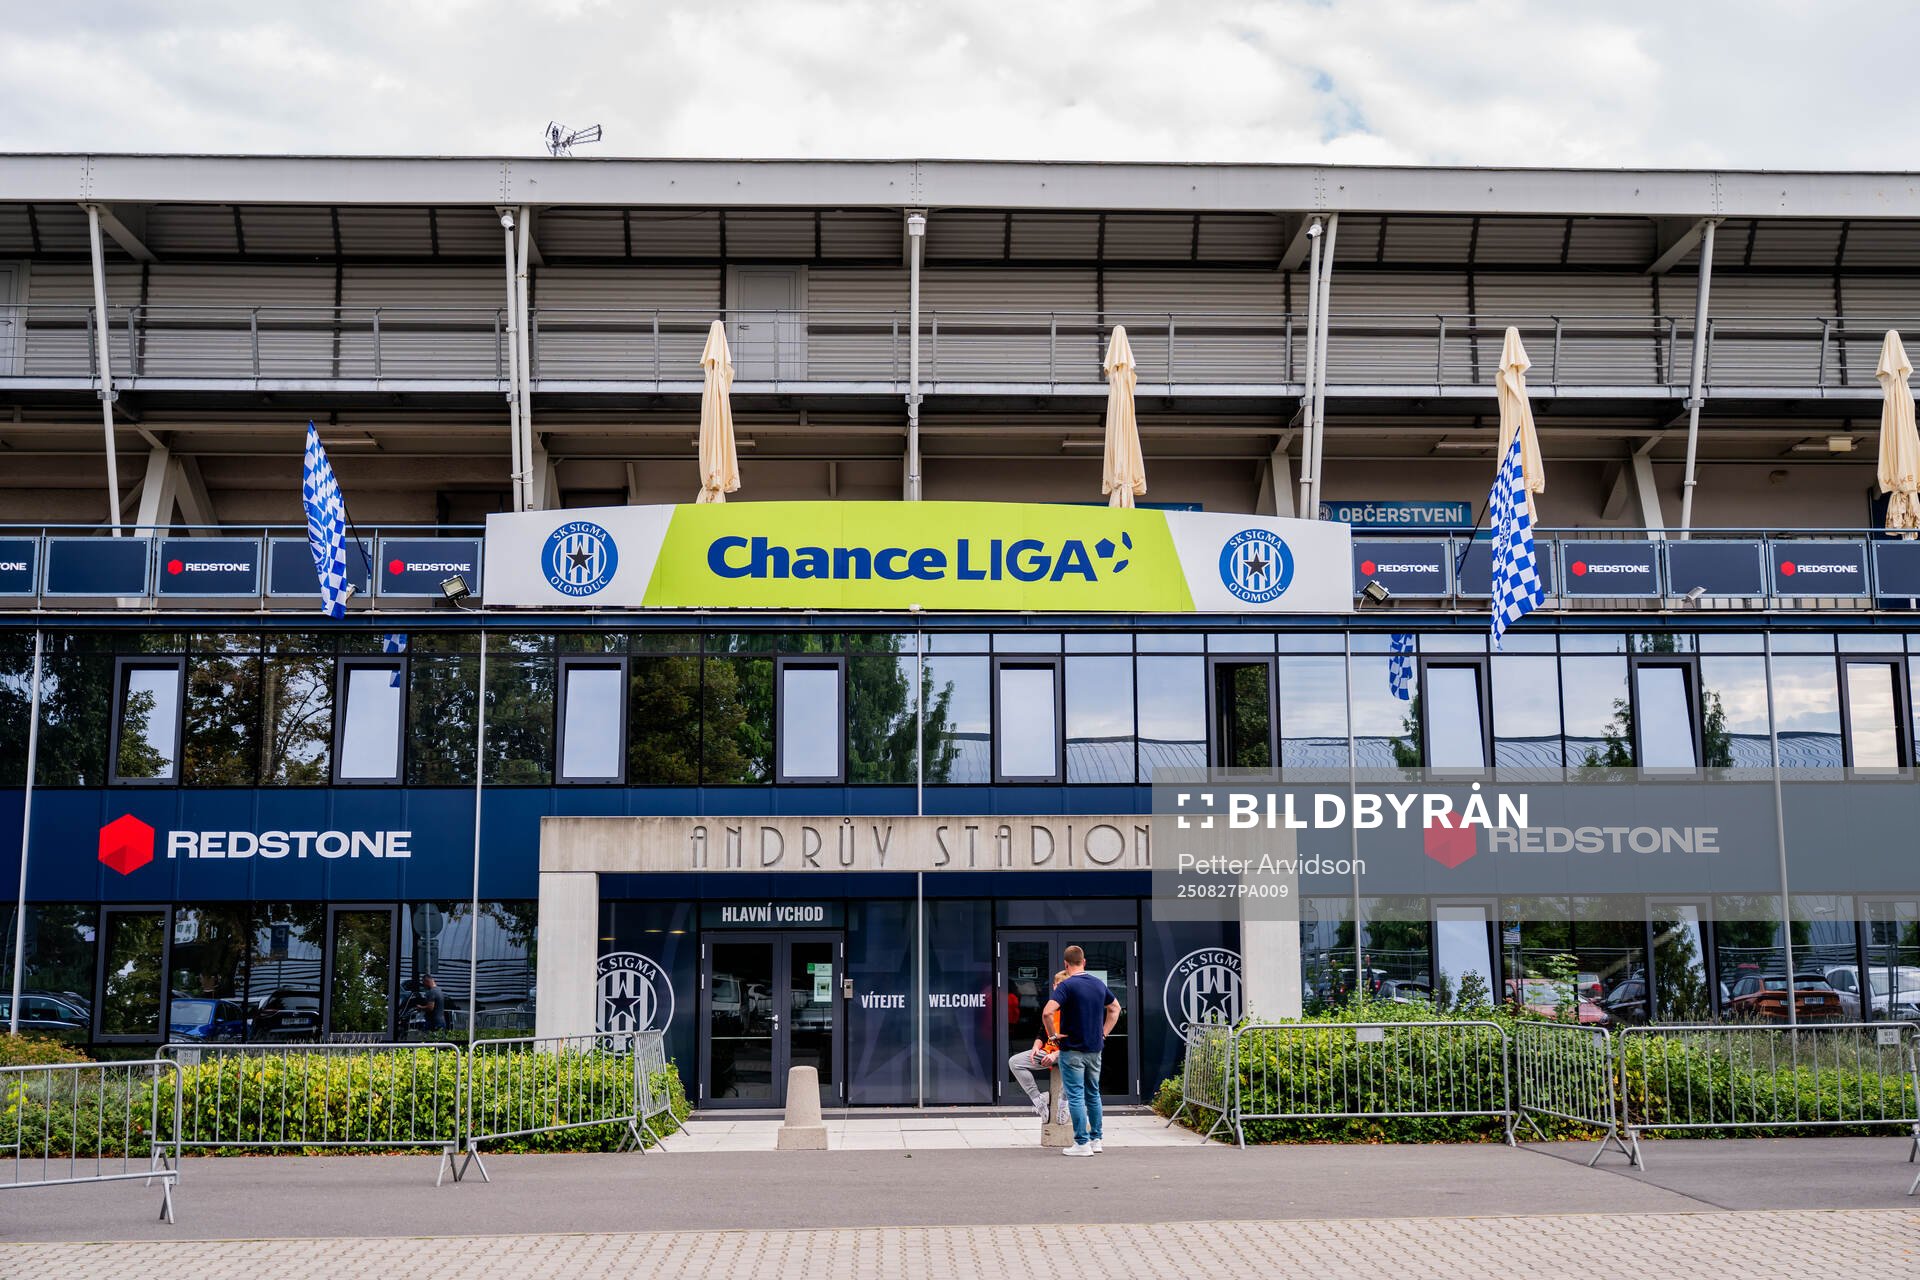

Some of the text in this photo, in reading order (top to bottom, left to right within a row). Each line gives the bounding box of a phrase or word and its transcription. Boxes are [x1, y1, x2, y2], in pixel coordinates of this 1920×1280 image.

[1338, 504, 1463, 523] OBČERSTVENÍ
[553, 523, 607, 542] SK SIGMA
[1229, 530, 1282, 550] SK SIGMA
[0, 562, 27, 571] ONE
[185, 563, 250, 572] REDSTONE
[406, 563, 471, 572] REDSTONE
[707, 536, 1097, 582] Chance LIGA
[1377, 564, 1440, 573] REDSTONE
[1588, 564, 1650, 573] REDSTONE
[1796, 564, 1858, 573] REDSTONE
[550, 575, 608, 595] OLOMOUC
[1228, 582, 1286, 602] OLOMOUC
[167, 830, 412, 859] REDSTONE
[690, 817, 1150, 868] ANDRŮV STADION
[1488, 826, 1720, 854] REDSTONE
[722, 903, 824, 922] HLAVNÍ VCHOD
[609, 957, 656, 980] SIGMA
[1180, 957, 1199, 976] SK
[861, 991, 905, 1009] VÍTEJTE
[928, 993, 986, 1008] WELCOME
